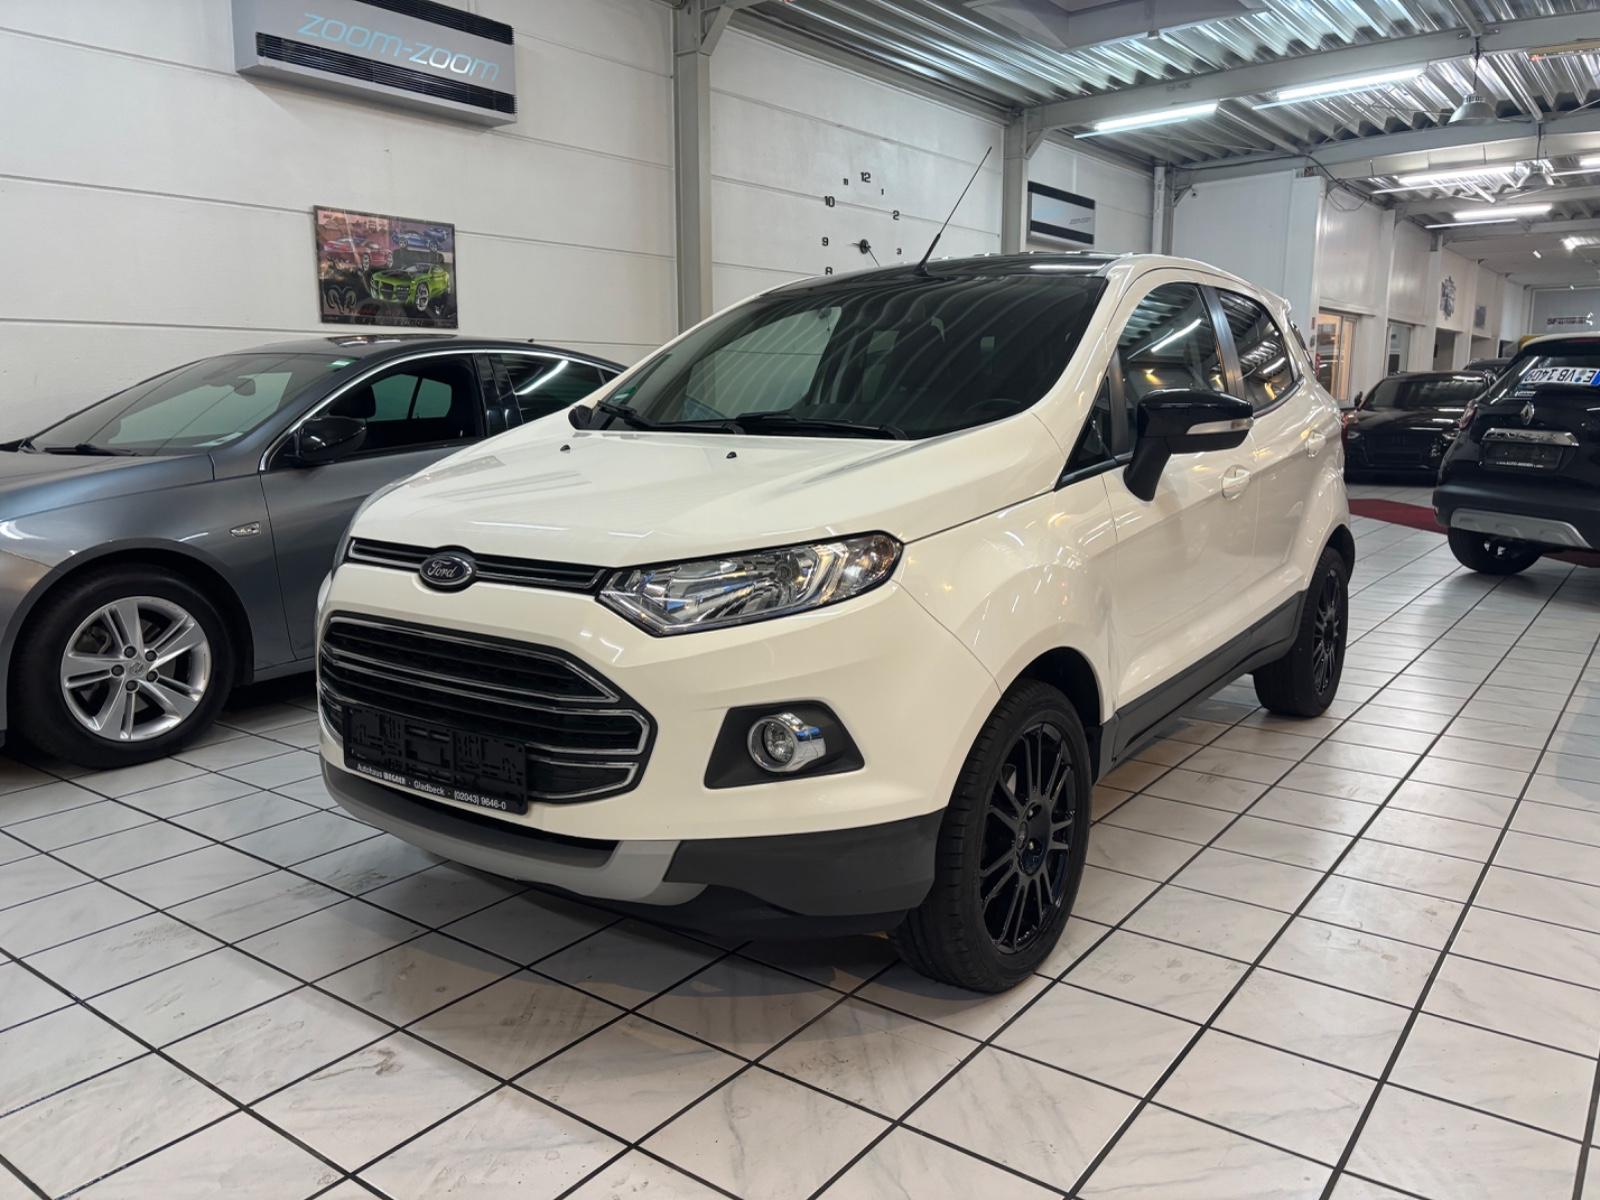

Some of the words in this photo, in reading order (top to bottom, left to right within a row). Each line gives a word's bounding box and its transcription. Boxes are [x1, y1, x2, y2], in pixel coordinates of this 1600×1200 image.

[297, 12, 499, 82] zoom-zoom
[860, 172, 872, 184] 12
[824, 195, 836, 208] 10
[892, 210, 900, 221] 2
[821, 236, 829, 247] 9
[427, 559, 458, 578] Ford
[357, 763, 382, 779] Autohaus
[413, 780, 446, 796] Gladbeck
[453, 790, 480, 806] (02043)
[481, 796, 506, 811] 9646-0
